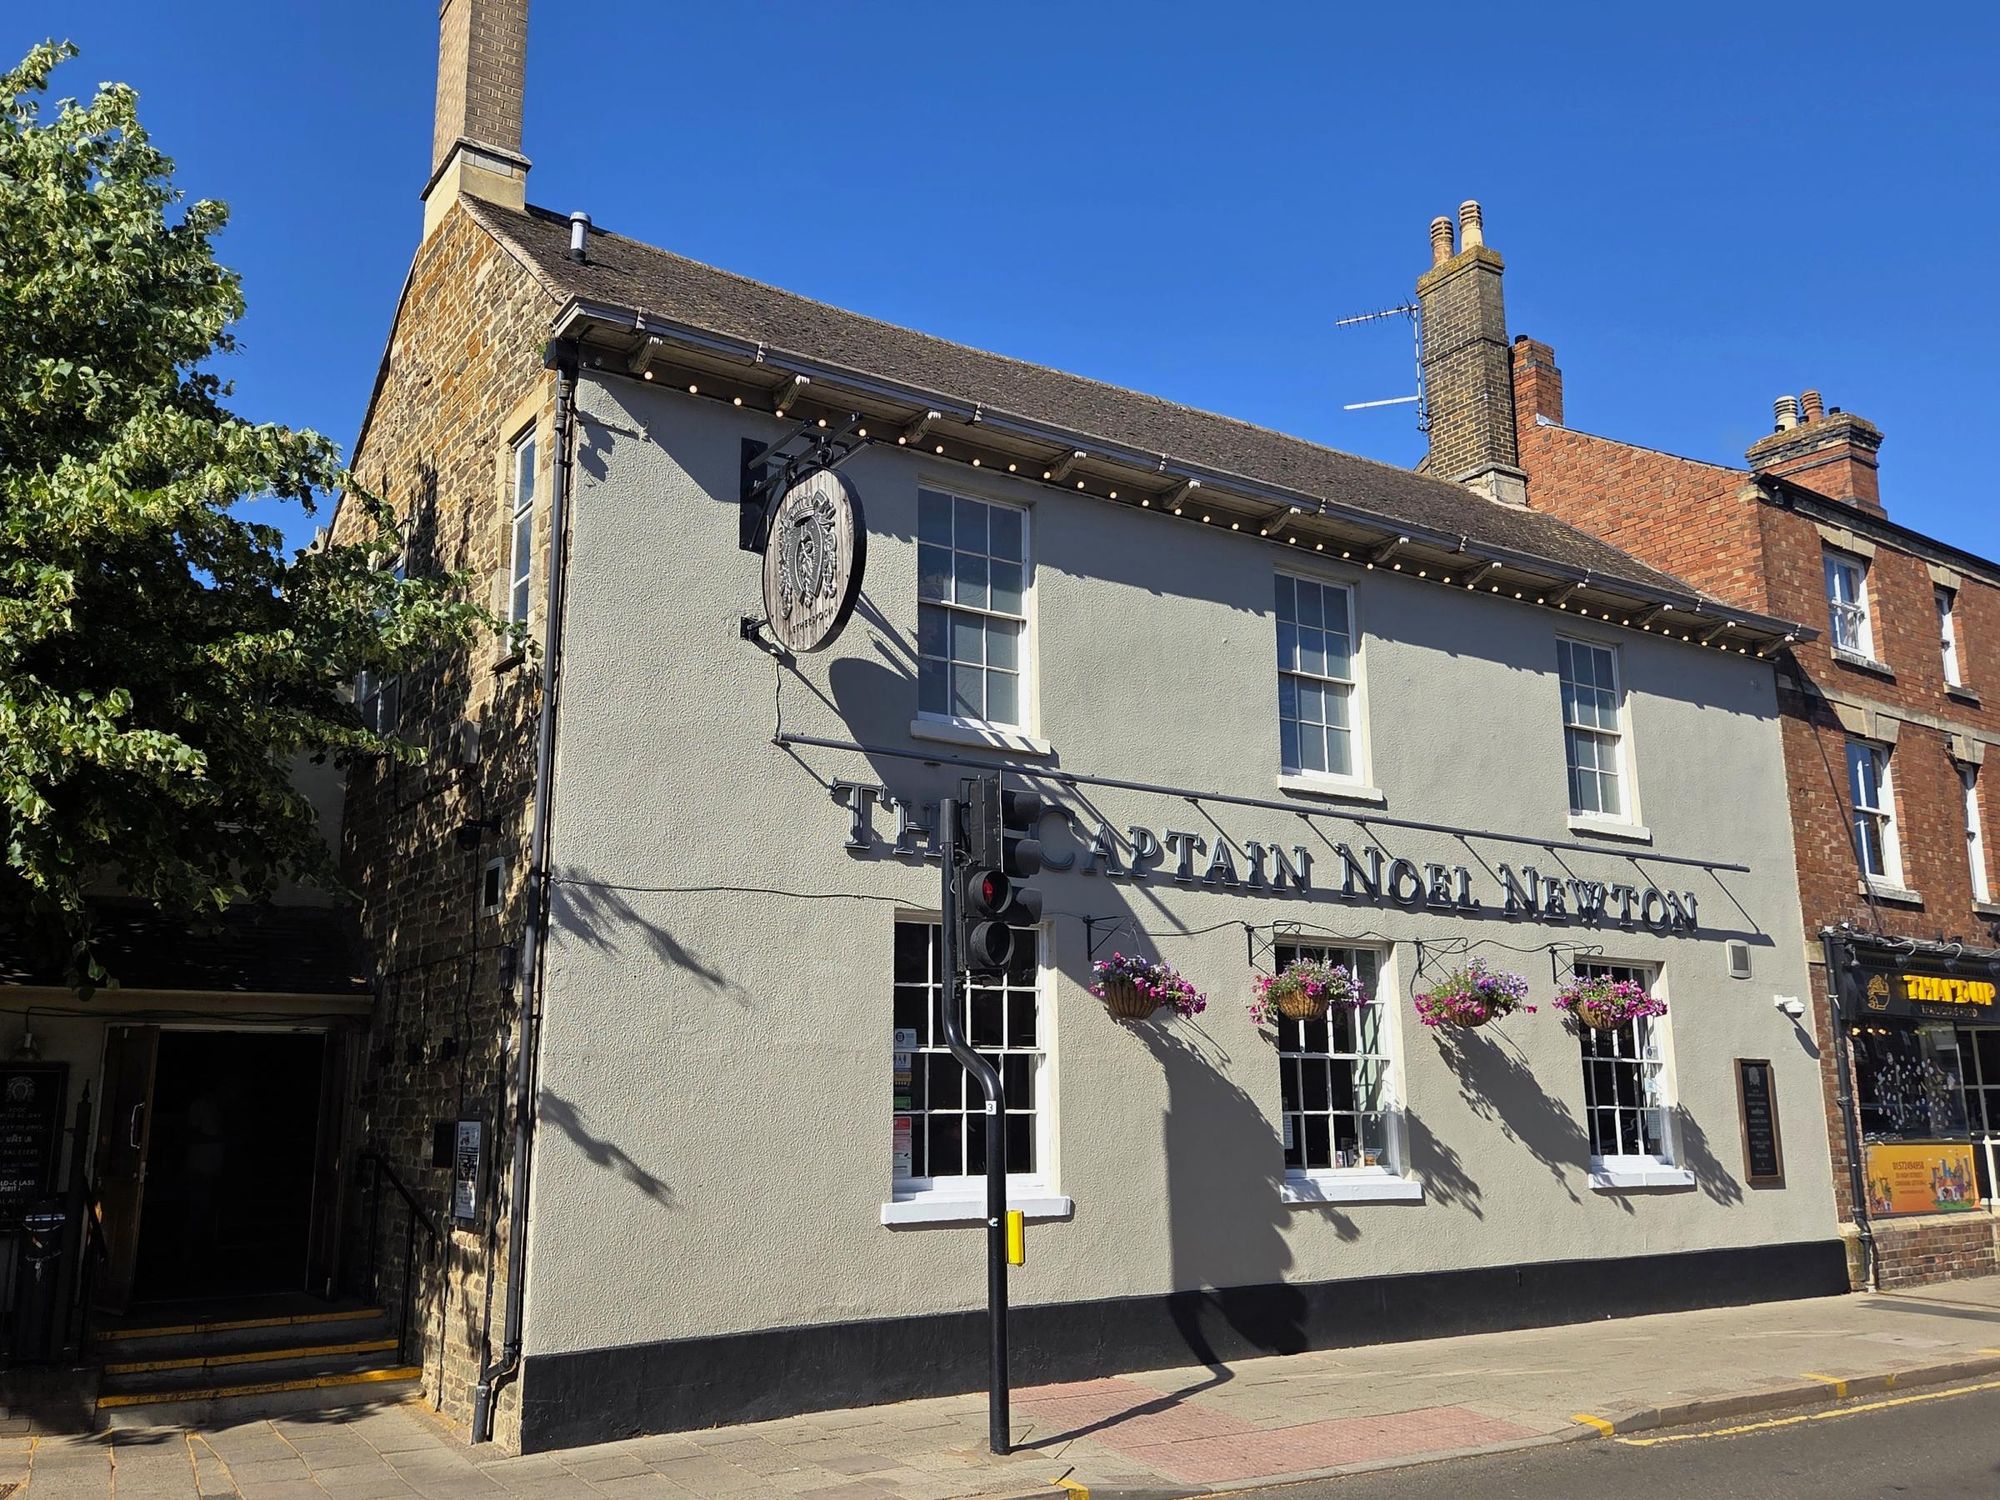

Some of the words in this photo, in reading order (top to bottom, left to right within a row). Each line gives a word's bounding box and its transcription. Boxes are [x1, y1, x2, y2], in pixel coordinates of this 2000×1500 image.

[791, 606, 834, 634] ETHERSPOON
[828, 776, 942, 858] TH
[1027, 804, 1308, 895] CAPTAIN
[1335, 842, 1480, 912] NOEL
[1497, 862, 1698, 933] NEWTON
[987, 1103, 994, 1112] 3
